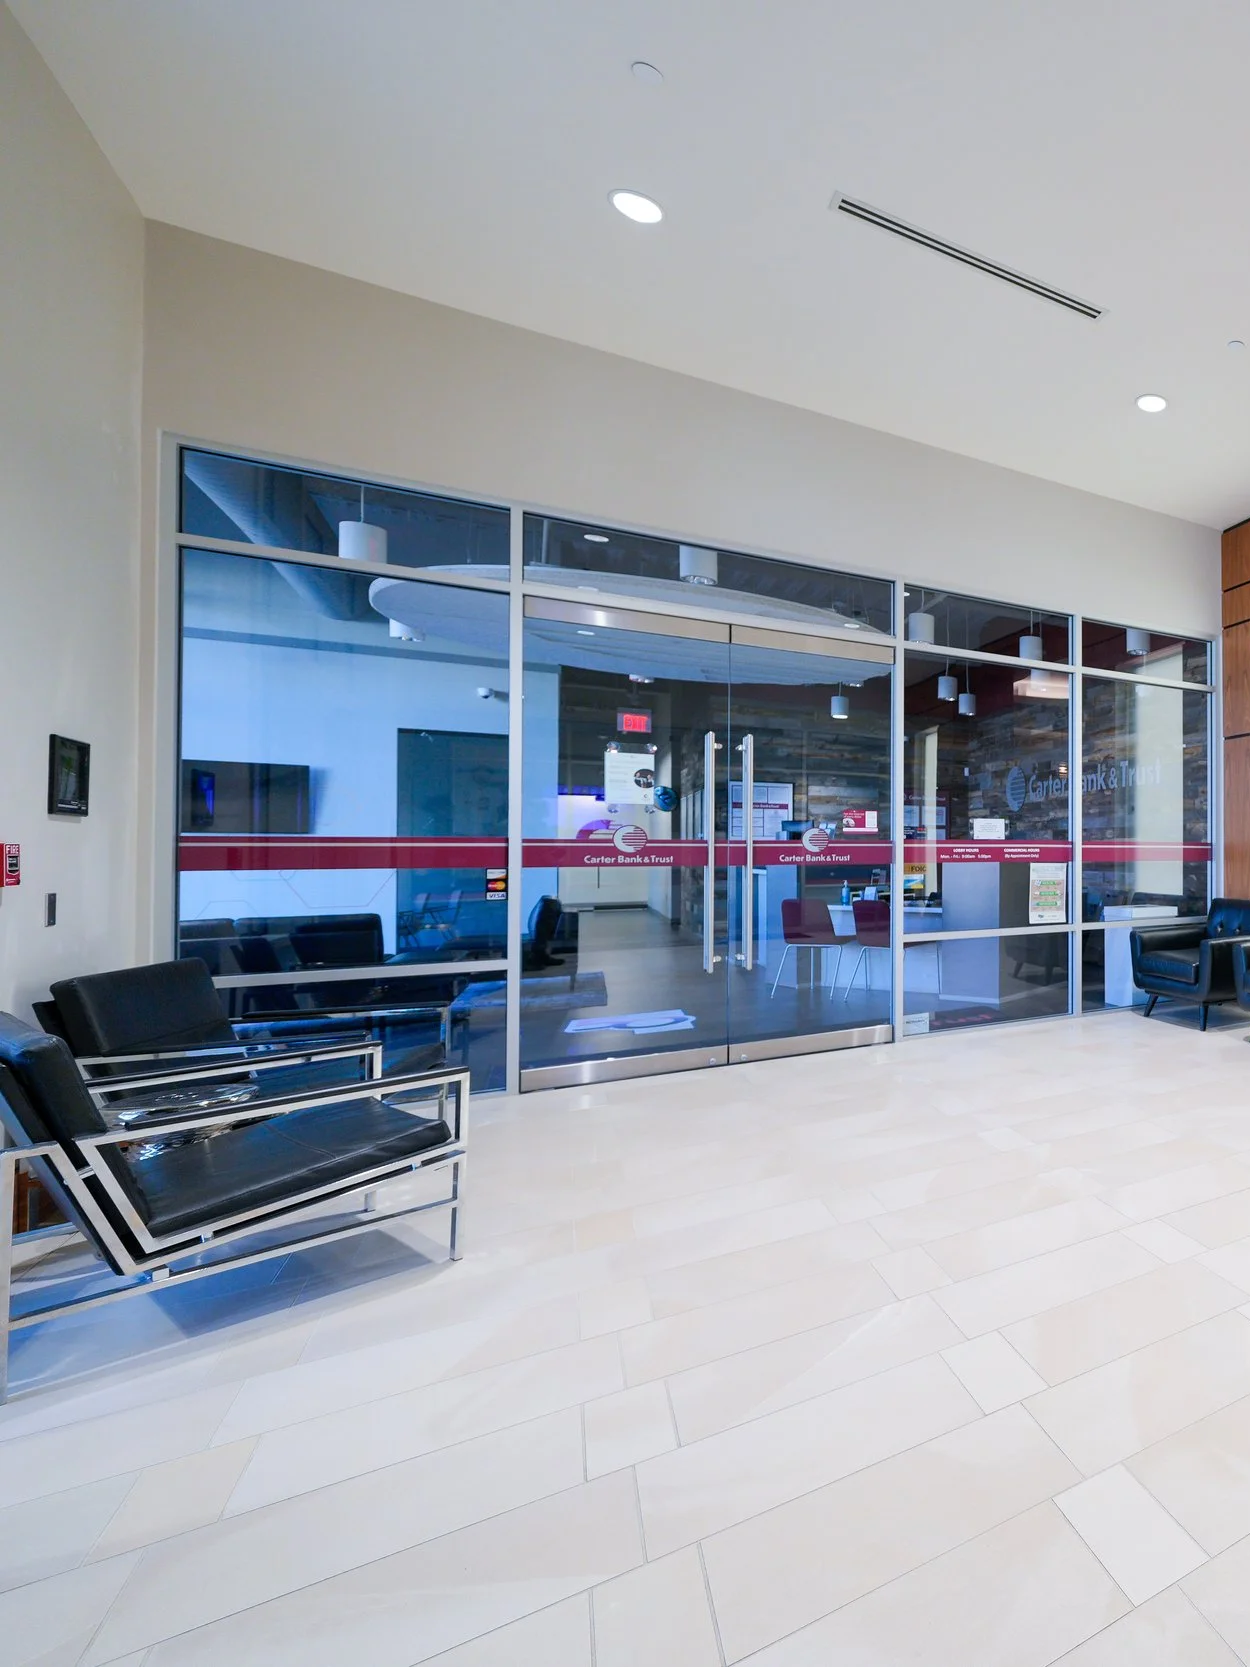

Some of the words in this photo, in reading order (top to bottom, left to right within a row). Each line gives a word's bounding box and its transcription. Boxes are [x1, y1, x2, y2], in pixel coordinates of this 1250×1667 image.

[1028, 774, 1067, 801] Carter
[1108, 769, 1118, 790] &
[1120, 757, 1162, 788] Trust
[5, 845, 19, 854] FIRE
[584, 855, 616, 864] Carter
[617, 855, 643, 863] Bank
[650, 855, 674, 863] Trust
[779, 854, 805, 862] Carter
[806, 854, 826, 862] Bank
[831, 854, 850, 862] Trust
